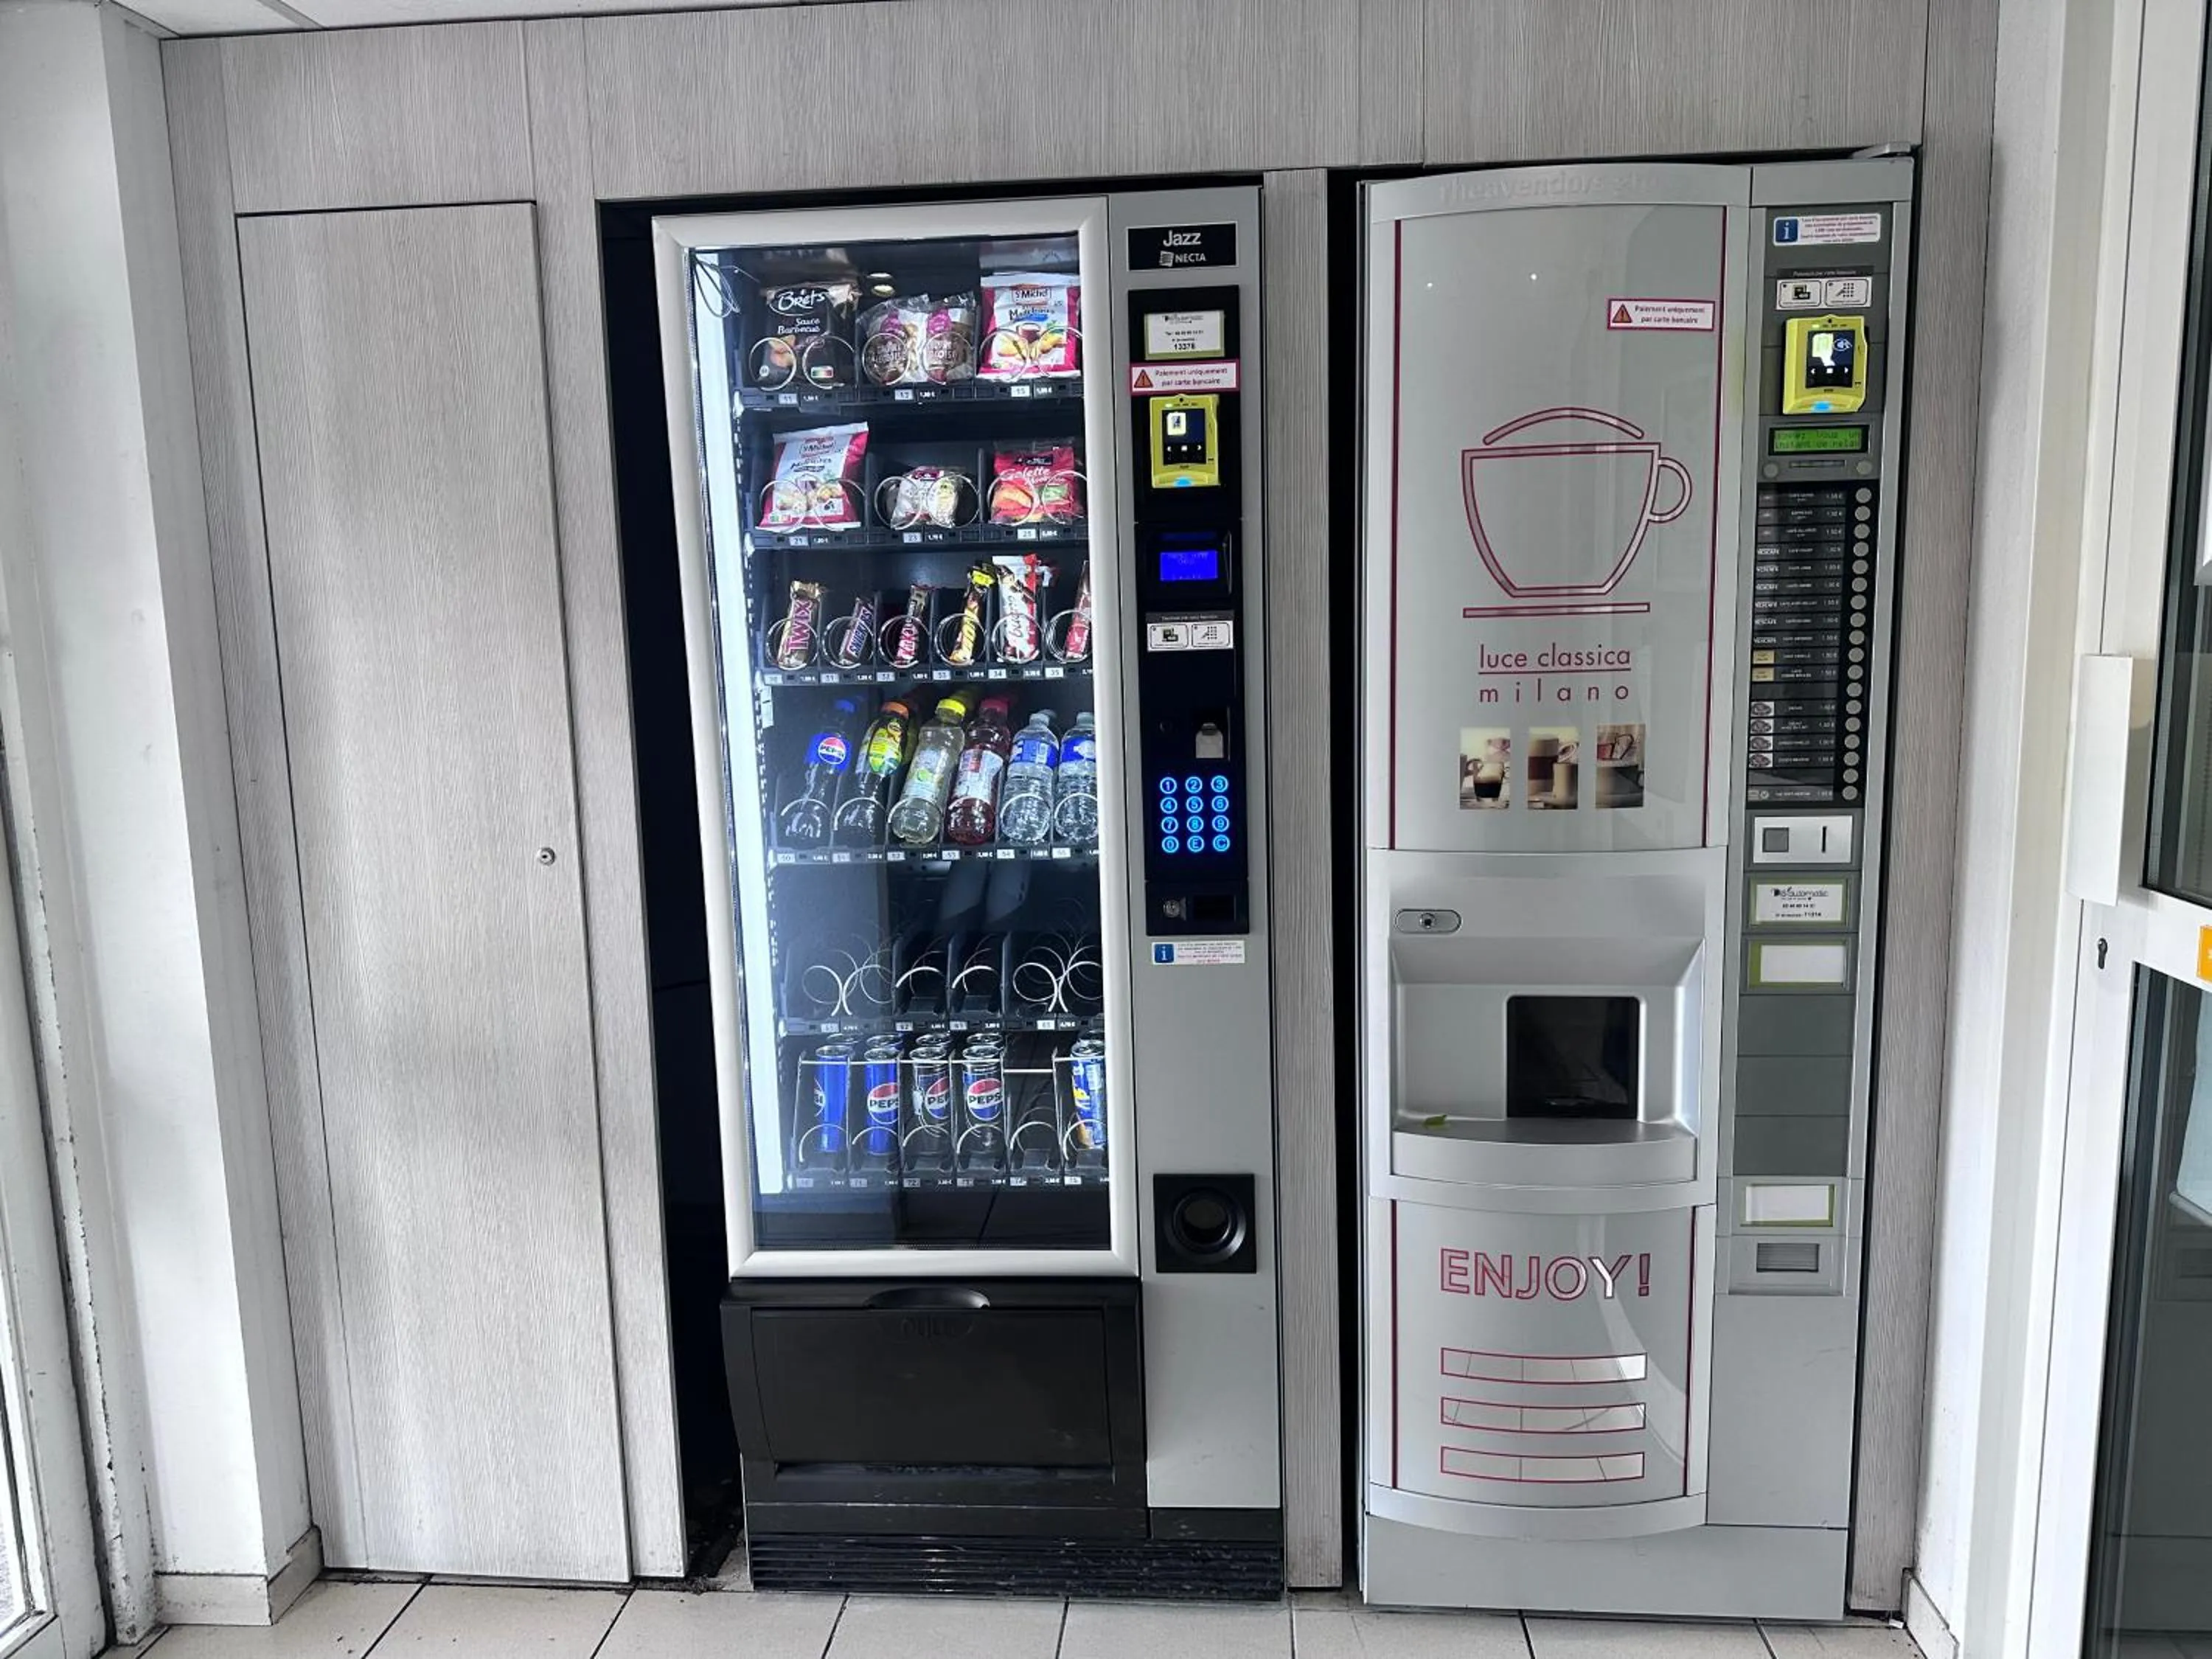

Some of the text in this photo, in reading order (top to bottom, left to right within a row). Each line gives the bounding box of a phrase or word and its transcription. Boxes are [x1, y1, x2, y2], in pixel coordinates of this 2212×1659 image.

[1163, 230, 1201, 246] Jazz
[1175, 253, 1206, 263] NECTA
[796, 318, 820, 326] Sauce
[1478, 642, 1631, 669] luce classica
[1478, 678, 1630, 702] milano
[869, 1099, 899, 1107] PEPS
[968, 1092, 1002, 1104] PEPS
[1440, 1248, 1651, 1301] ENJOY!
